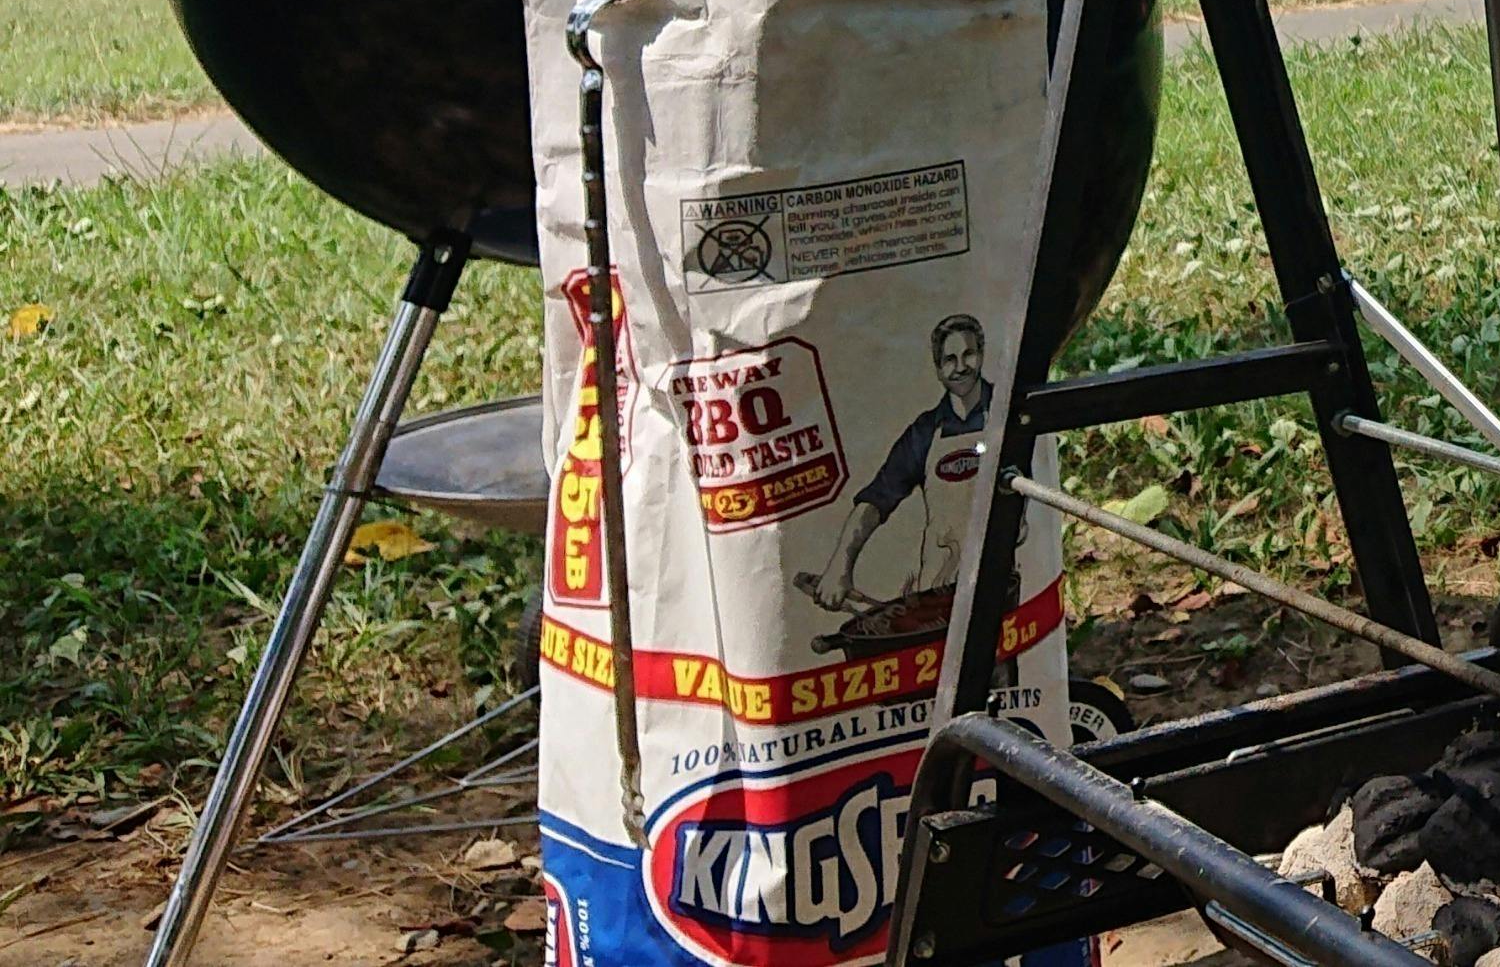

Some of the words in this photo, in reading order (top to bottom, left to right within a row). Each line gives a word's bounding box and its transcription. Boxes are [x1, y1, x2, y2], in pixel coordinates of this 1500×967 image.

[698, 195, 779, 219] WARNING
[785, 189, 843, 208] CARBON
[845, 177, 912, 199] MONOXIDE
[913, 168, 959, 187] HAZARD
[787, 207, 840, 223] Burning
[843, 197, 898, 215] charcoal
[901, 190, 938, 205] inside
[939, 185, 961, 198] can
[788, 221, 807, 234] kill
[852, 212, 887, 228] gives
[907, 199, 952, 216] carbon
[791, 248, 840, 263] NEVER
[672, 376, 708, 395] THE
[709, 357, 783, 390] WAY
[682, 386, 792, 447] BBQ
[741, 424, 824, 473] TASTE
[762, 465, 829, 499] FASTER
[541, 621, 570, 667] UE
[571, 636, 616, 688] SIZ
[672, 658, 772, 720] VAUE
[791, 657, 900, 715] SIZE
[671, 742, 738, 775] 100%
[577, 898, 591, 951] 100%
